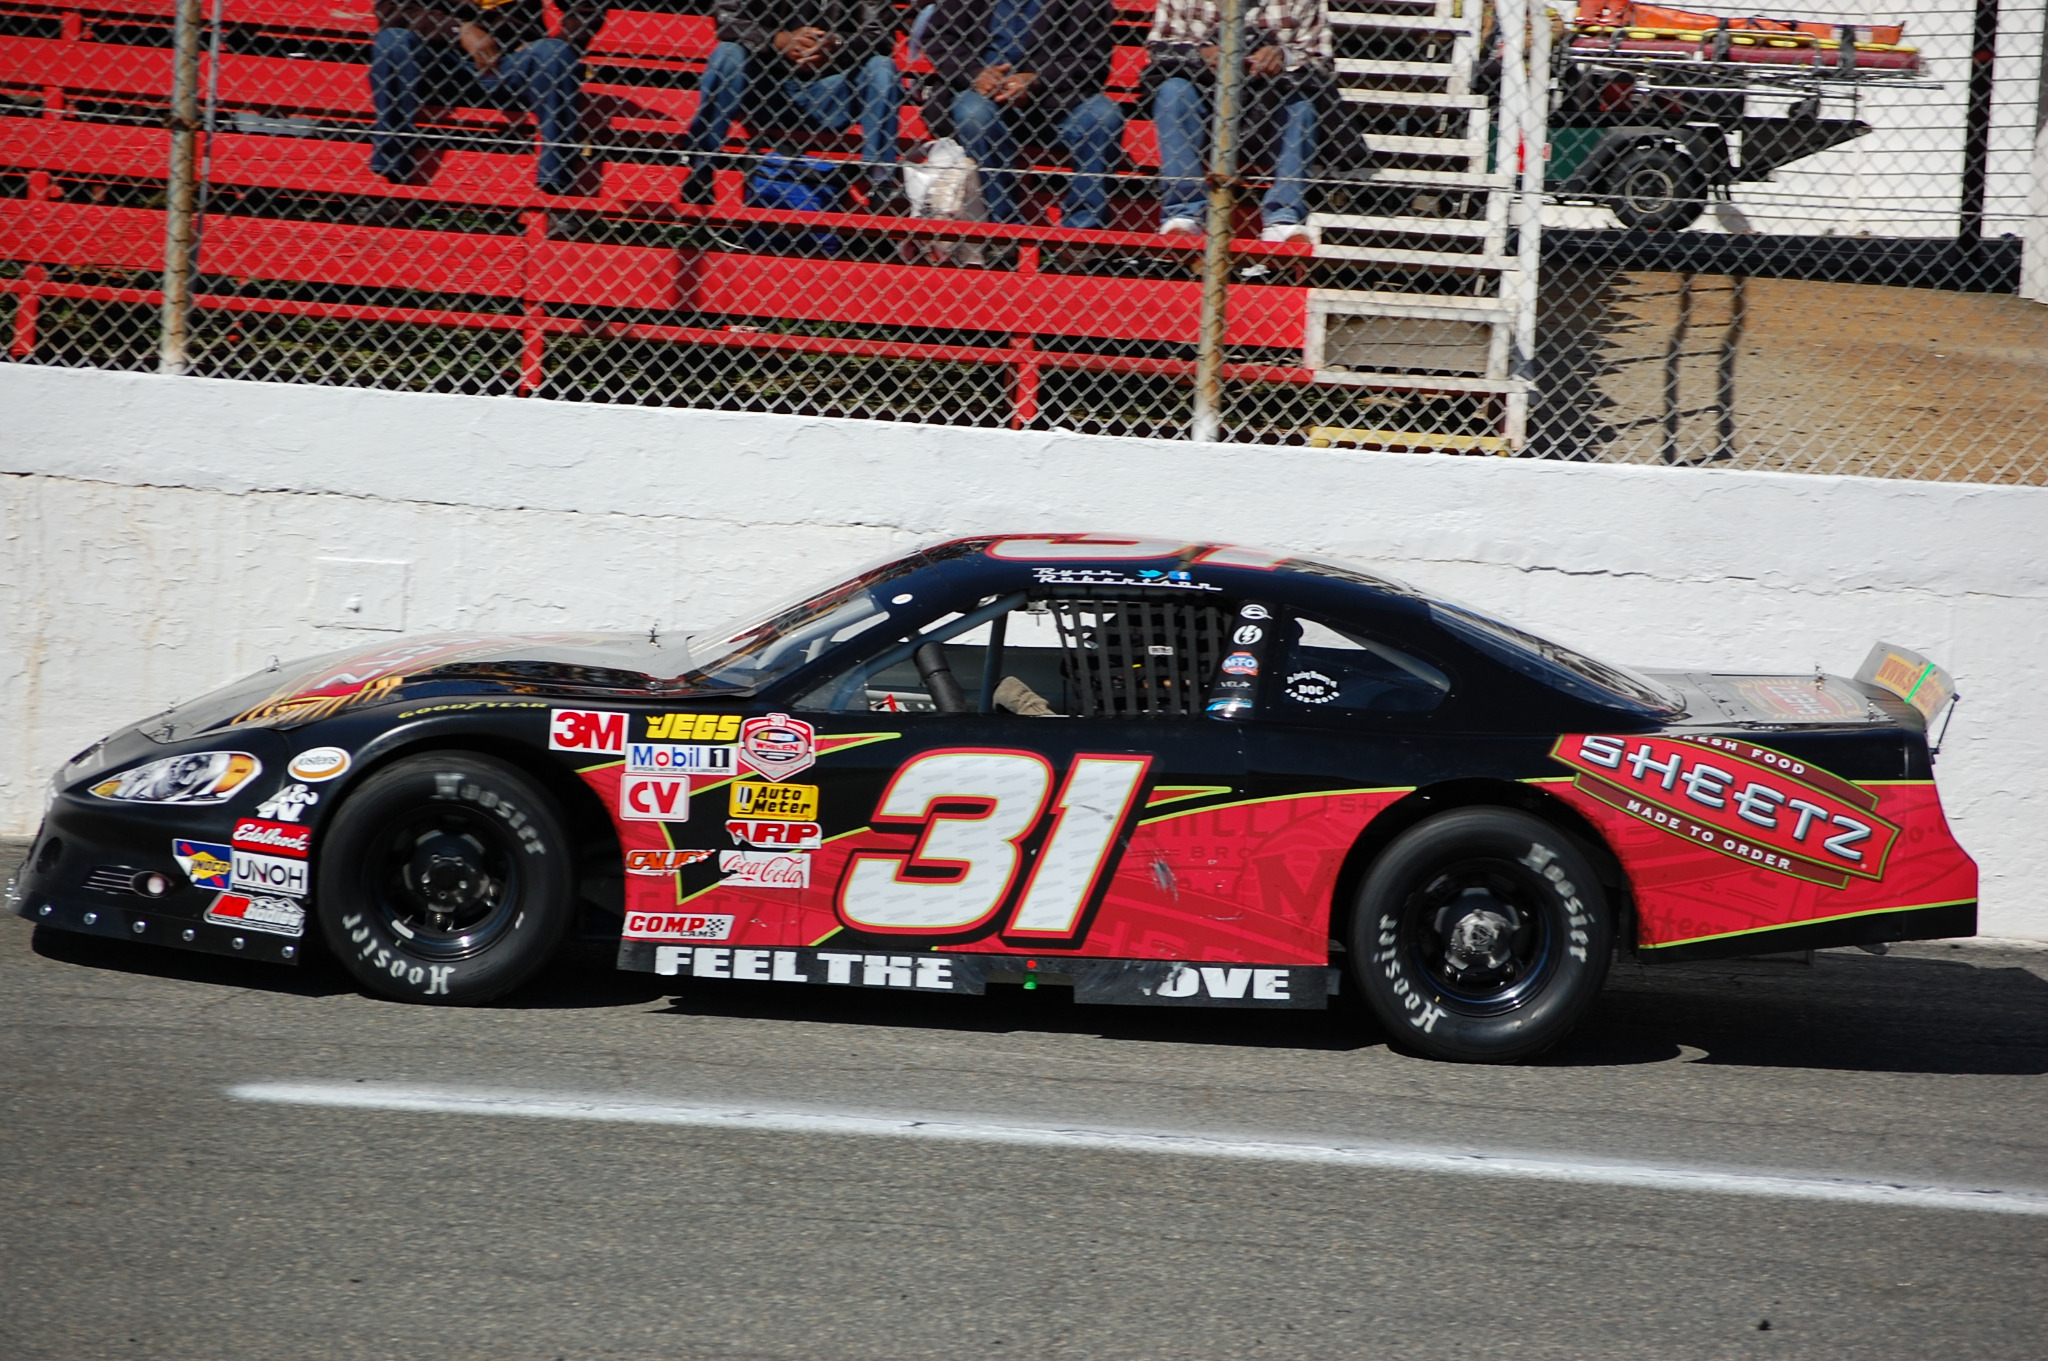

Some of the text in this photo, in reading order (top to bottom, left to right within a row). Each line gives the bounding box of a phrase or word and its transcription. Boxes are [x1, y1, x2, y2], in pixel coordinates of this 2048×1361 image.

[1298, 684, 1324, 695] DOC
[397, 701, 548, 720] GOODYEAR
[553, 711, 624, 751] 3M
[646, 713, 742, 740] JEGS
[297, 753, 340, 766] jostens
[632, 745, 727, 767] Mobil 1
[1670, 734, 1806, 775] ESH FOOD
[629, 781, 681, 813] CV
[753, 799, 811, 814] Meter
[757, 786, 802, 800] Auto
[1578, 734, 1872, 861] SHEETZ
[232, 823, 310, 852] Edelbrock
[726, 822, 819, 844] ARP
[840, 747, 1154, 940] 31
[1626, 799, 1791, 871] MADE TO ORDER
[236, 858, 304, 890] UNOH
[722, 854, 806, 884] Coca-Cola
[629, 915, 706, 933] COMP
[680, 930, 718, 938] CAMS
[342, 912, 456, 995] Hoosier
[654, 945, 954, 990] FEEL THE
[1140, 966, 1291, 1000] OVE
[1373, 913, 1448, 1034] Hoosier
